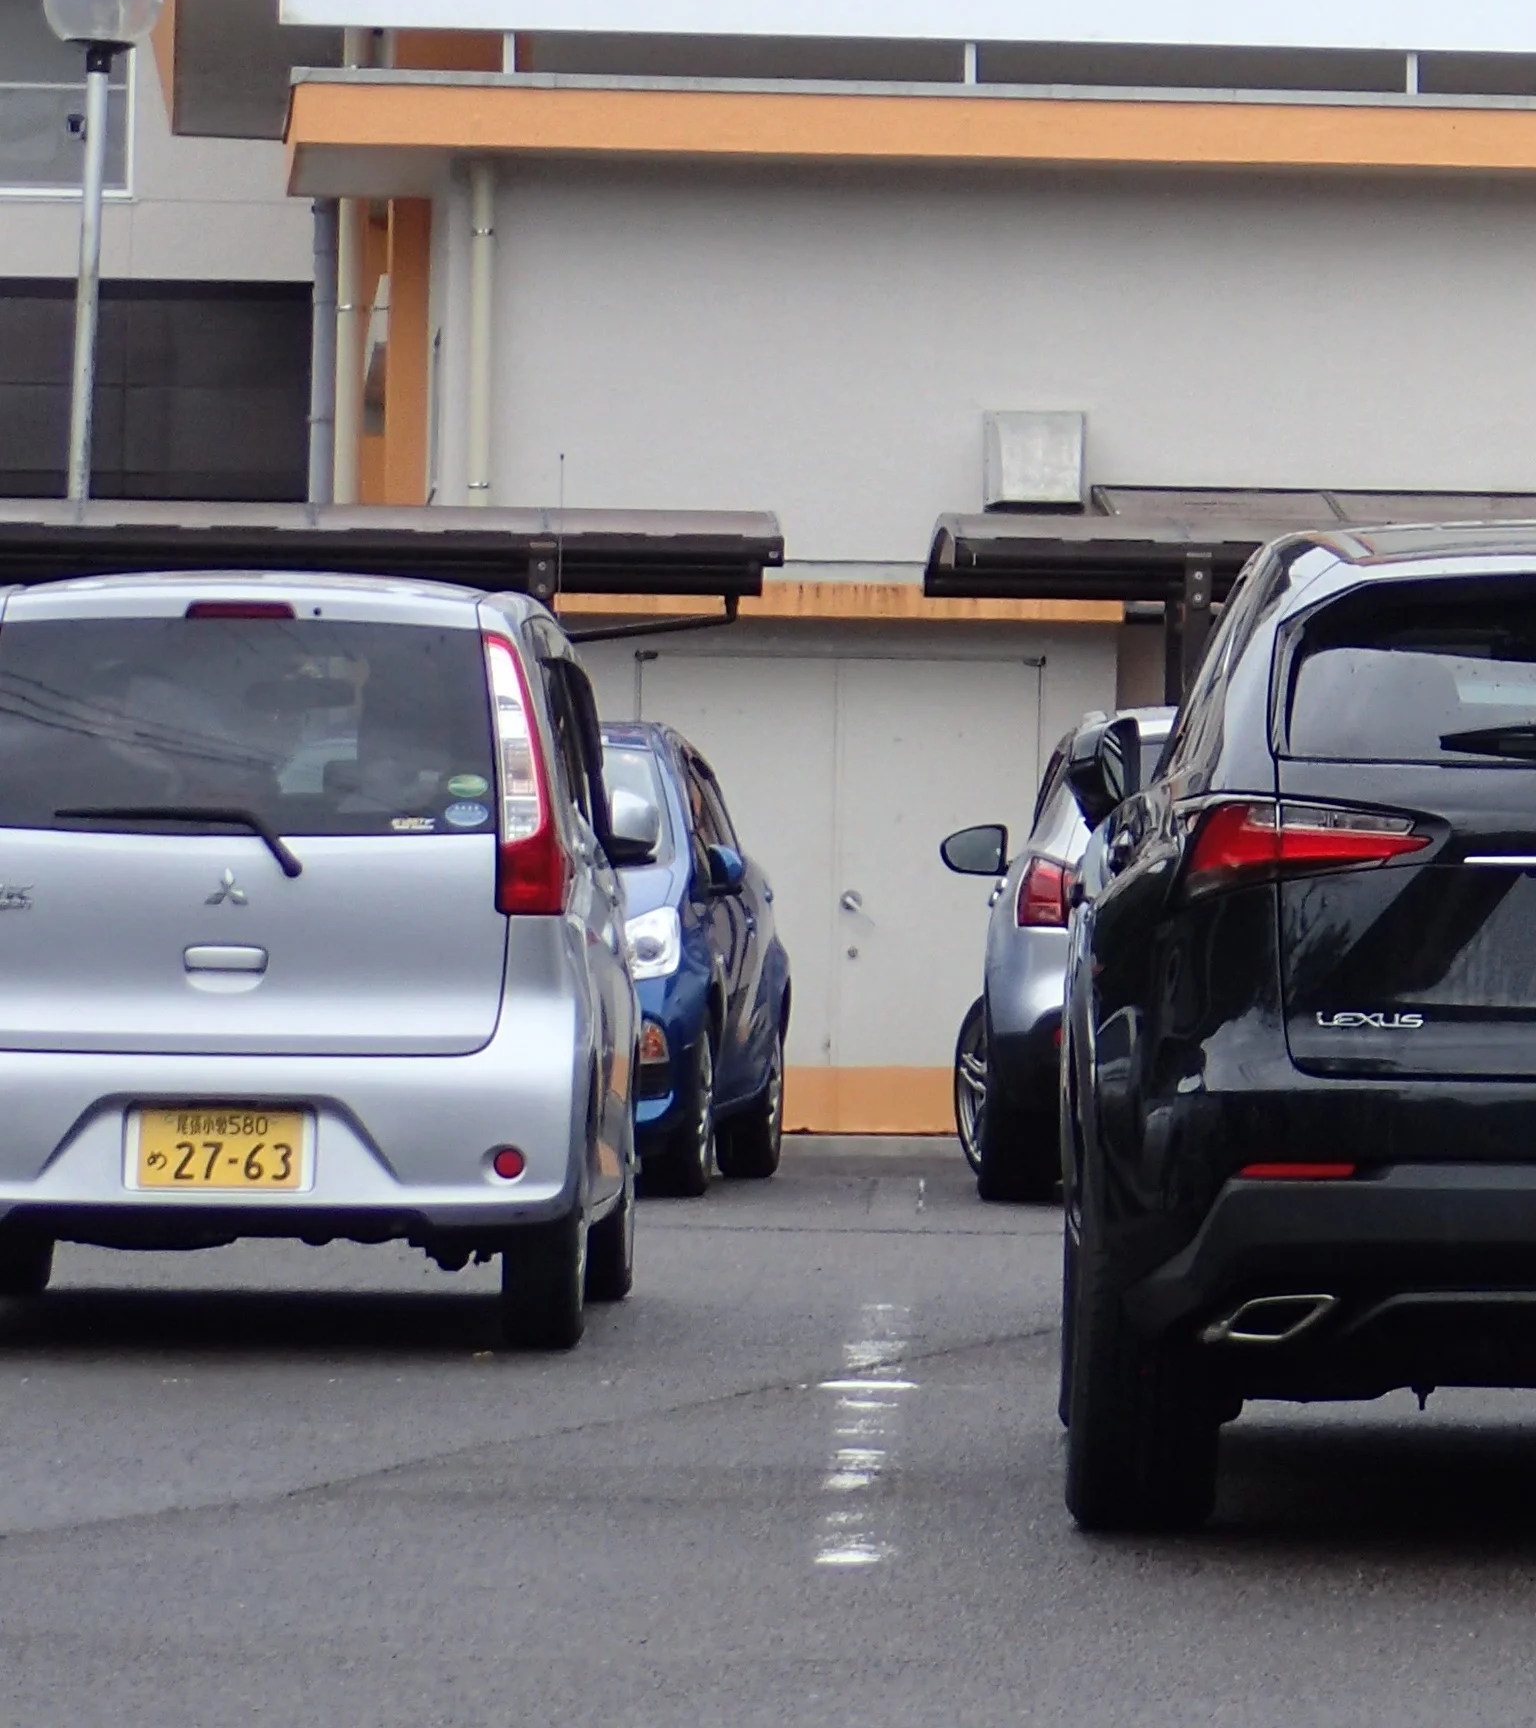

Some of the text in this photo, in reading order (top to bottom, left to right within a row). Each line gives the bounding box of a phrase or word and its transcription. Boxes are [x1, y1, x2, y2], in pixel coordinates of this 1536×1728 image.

[1316, 1011, 1424, 1028] LEXUS
[147, 1141, 293, 1181] め 27-63
